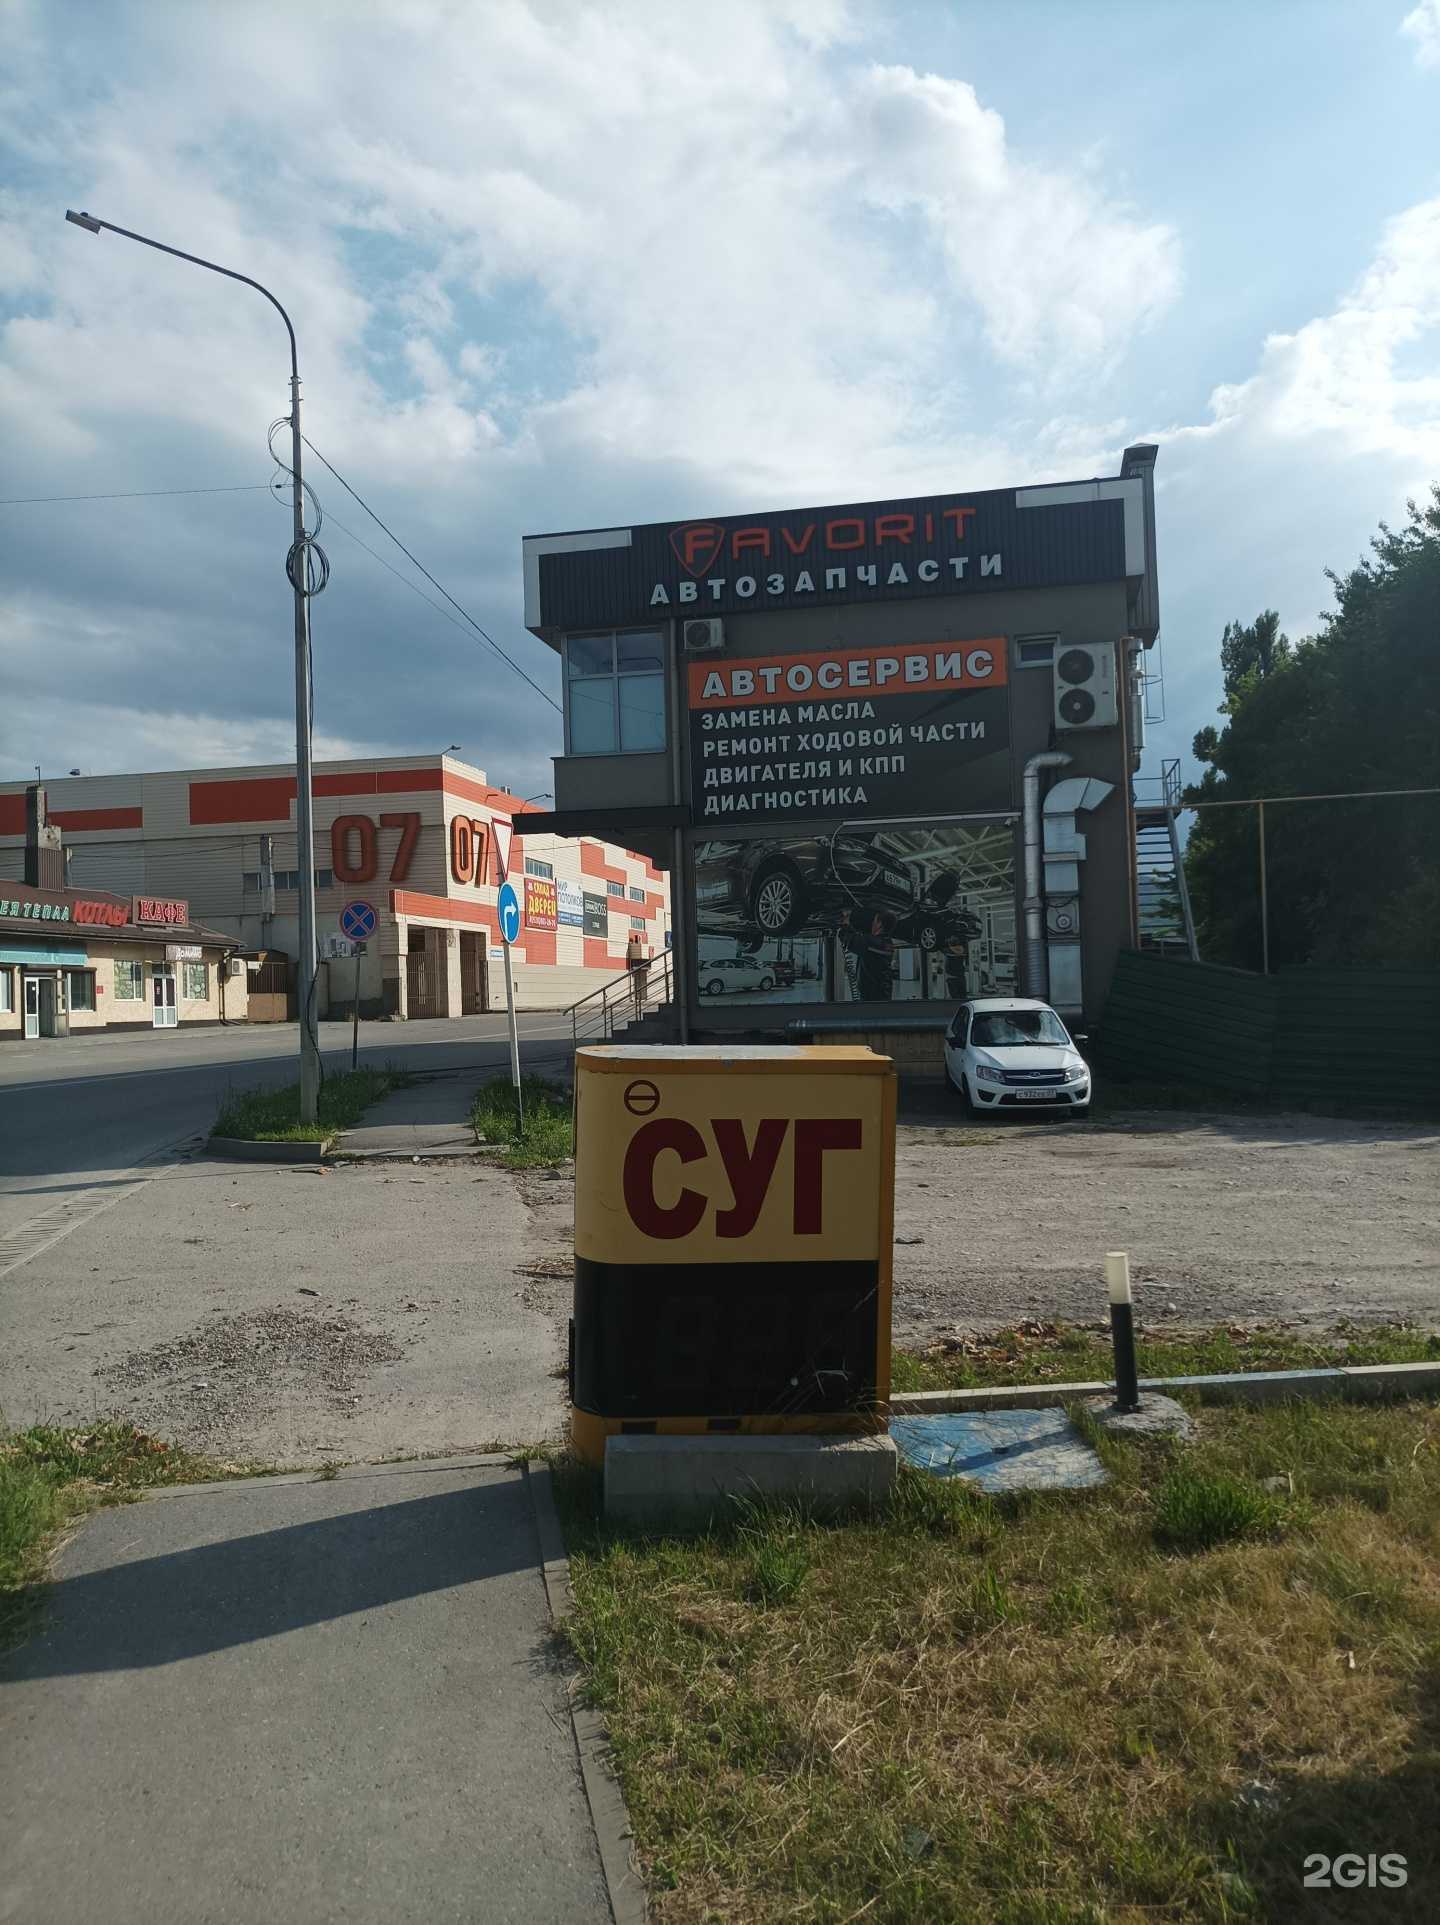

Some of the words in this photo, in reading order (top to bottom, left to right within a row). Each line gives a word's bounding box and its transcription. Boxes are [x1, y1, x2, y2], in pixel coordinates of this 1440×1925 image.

[683, 508, 976, 565] FAVORIT
[650, 553, 1002, 605] АВТОЗАПЧАСТИ
[702, 650, 993, 698] АВТОСЕРВИС
[702, 707, 792, 730] ЗАМЕНА
[798, 701, 876, 723] МАСЛА
[703, 735, 790, 757] РЕМОНТ
[797, 723, 903, 752] ХОДОВОЙ
[910, 721, 985, 743] ЧАСТИ
[703, 760, 831, 788] ДВИГАТЕЛЯ
[838, 759, 852, 776] И
[859, 755, 905, 775] КПП
[704, 786, 868, 816] ДИАГНОСТИКА
[331, 812, 421, 882] 07
[450, 815, 489, 888] 07
[140, 900, 186, 923] КАФЕ
[623, 1118, 862, 1240] СУГ
